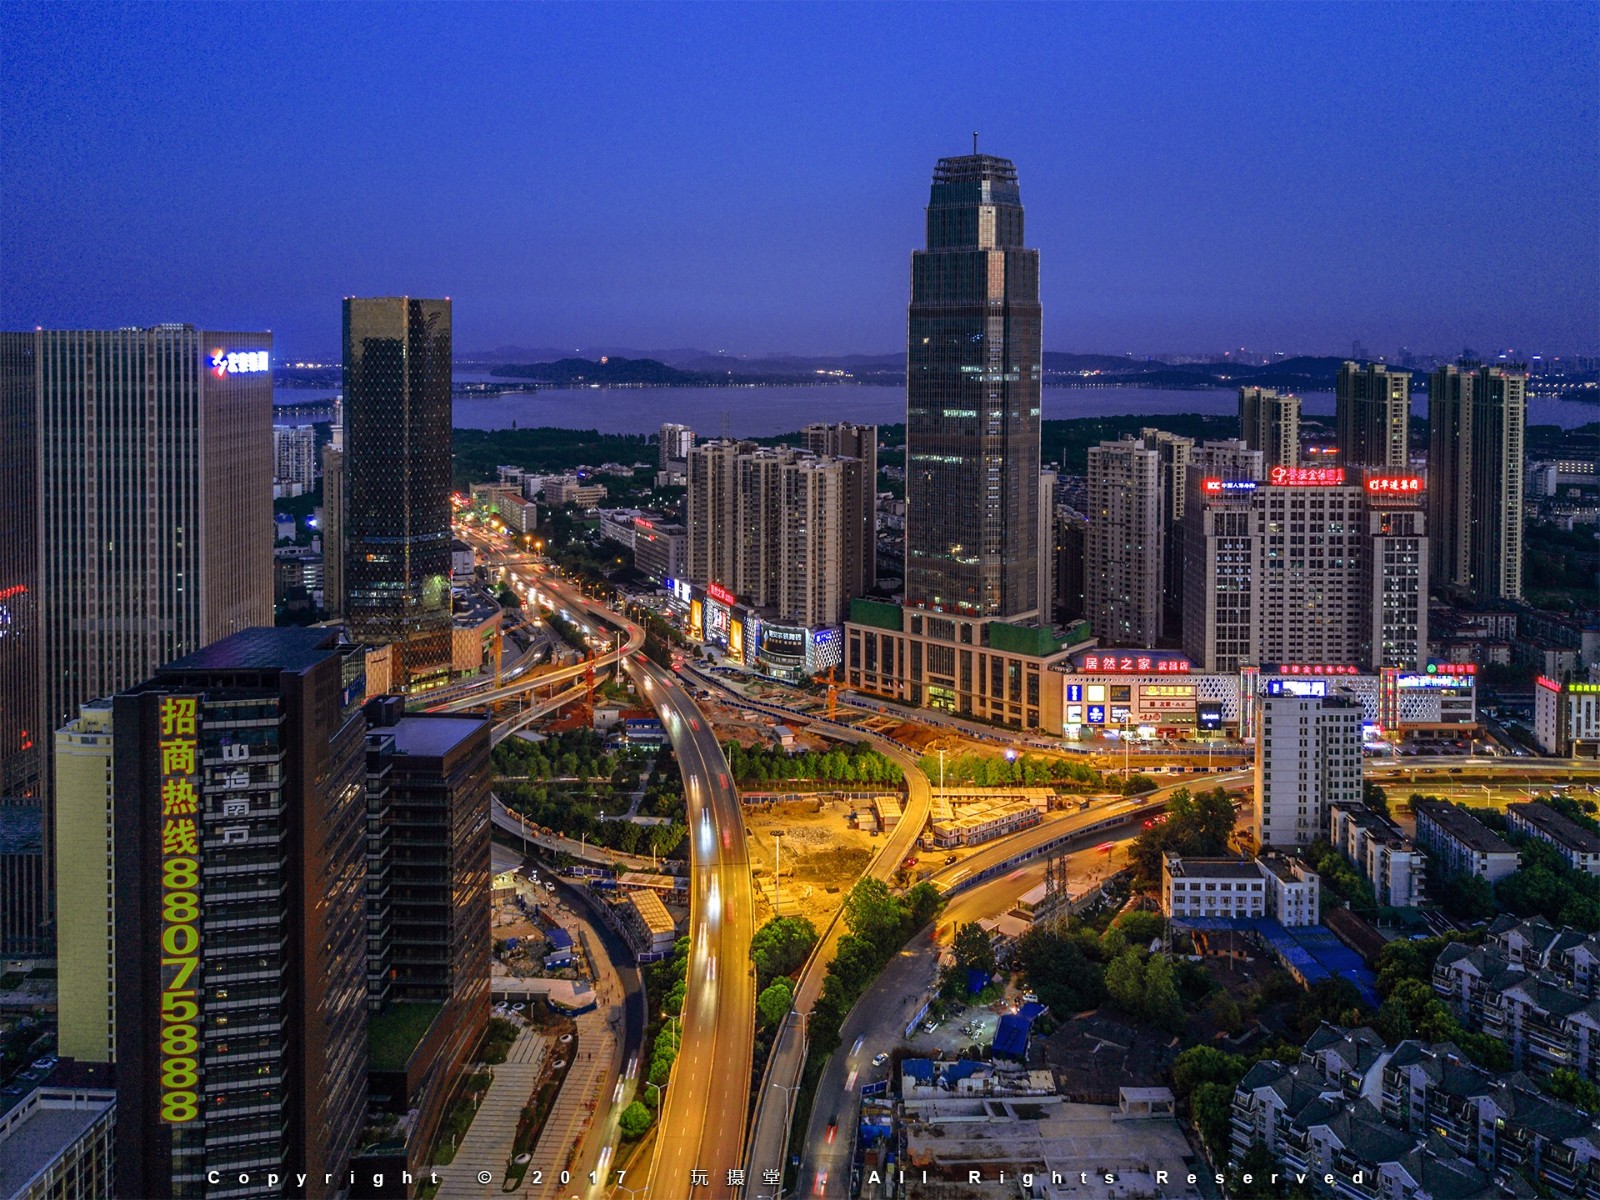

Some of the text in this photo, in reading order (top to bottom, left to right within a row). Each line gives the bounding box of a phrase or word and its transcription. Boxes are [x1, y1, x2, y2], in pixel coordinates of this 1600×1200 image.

[1085, 657, 1189, 671] 居然之家 武昌店
[222, 743, 250, 844] 中冶南方
